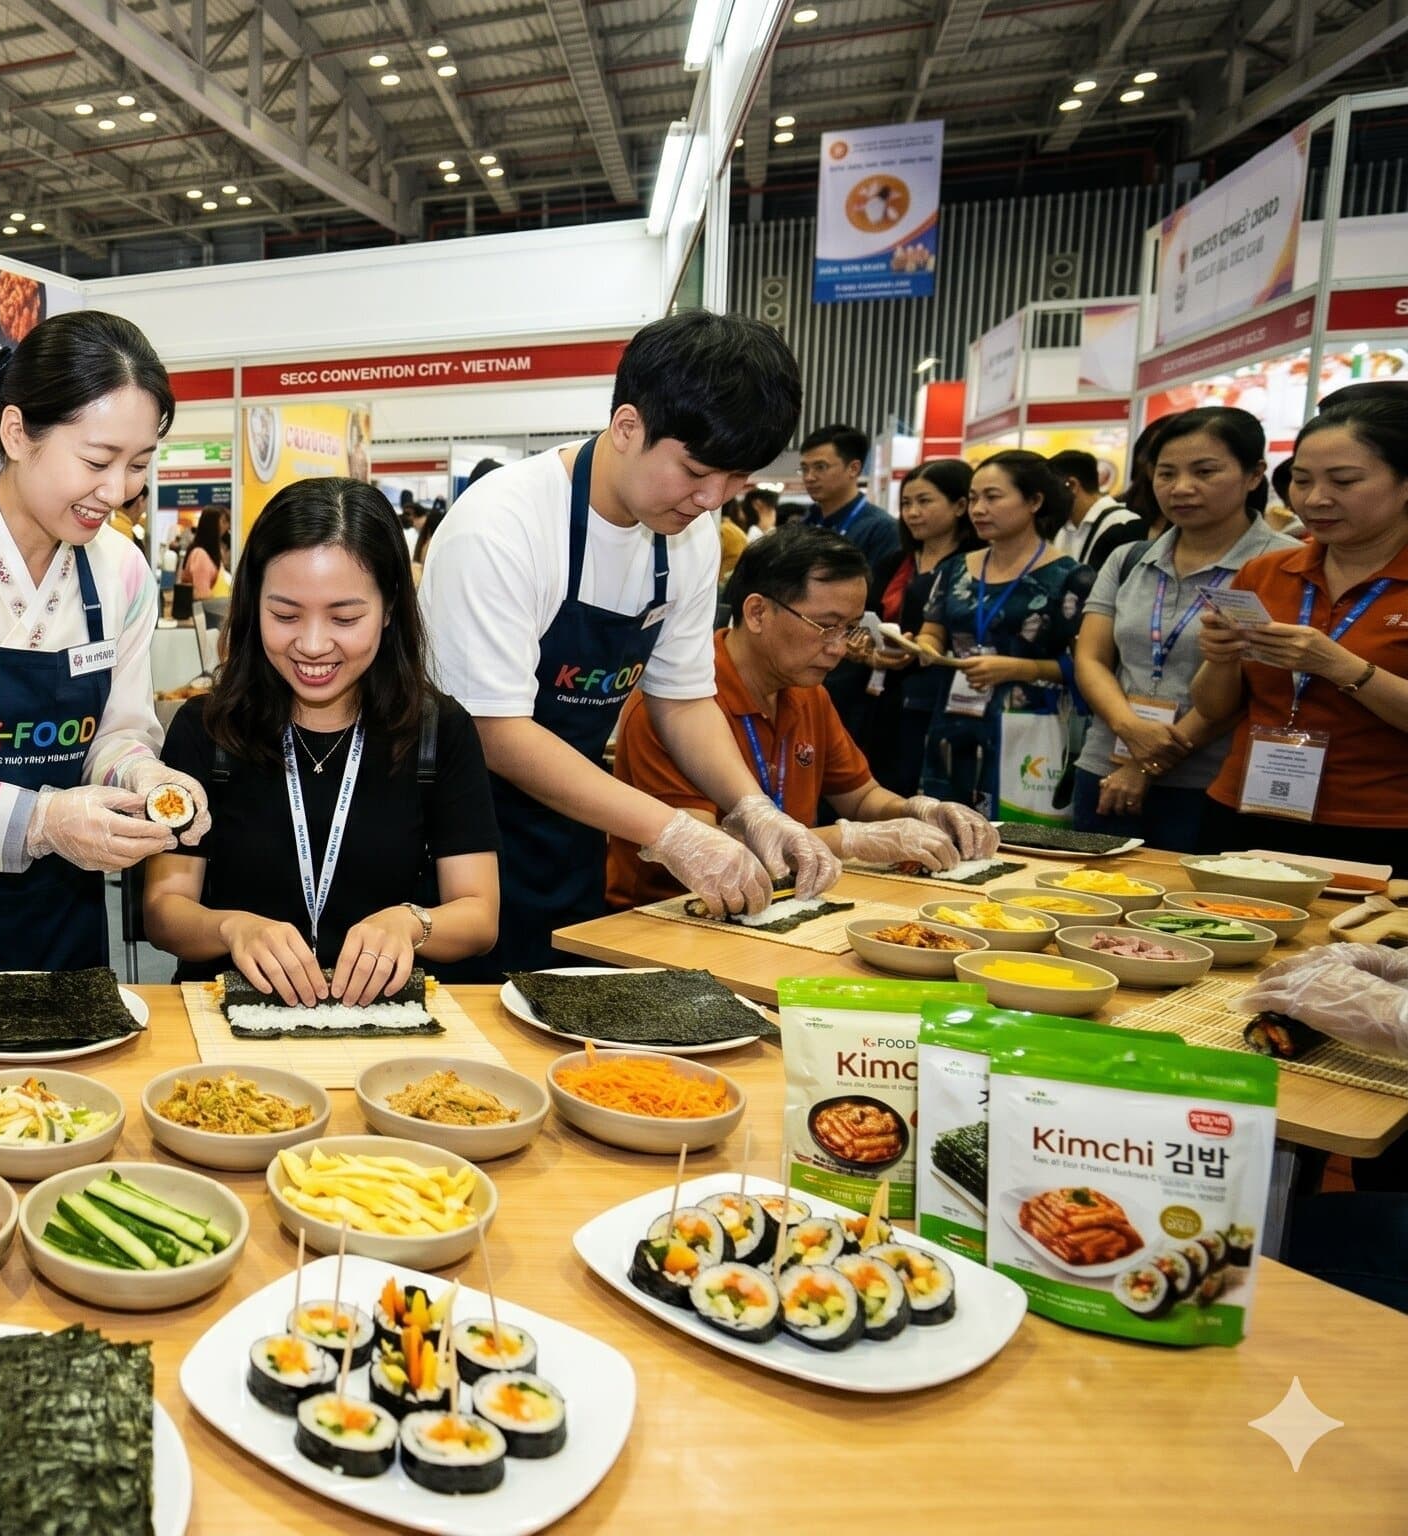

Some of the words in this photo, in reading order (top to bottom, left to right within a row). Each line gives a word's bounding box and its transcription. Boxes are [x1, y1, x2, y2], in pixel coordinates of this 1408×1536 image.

[280, 371, 318, 386] SECC
[320, 364, 415, 383] CONVENTION
[418, 361, 452, 377] CITY
[461, 356, 531, 374] VIETNAM
[837, 1051, 919, 1081] Kimc
[1033, 1126, 1154, 1167] Kimchi
[1164, 1142, 1231, 1180] 김밥
